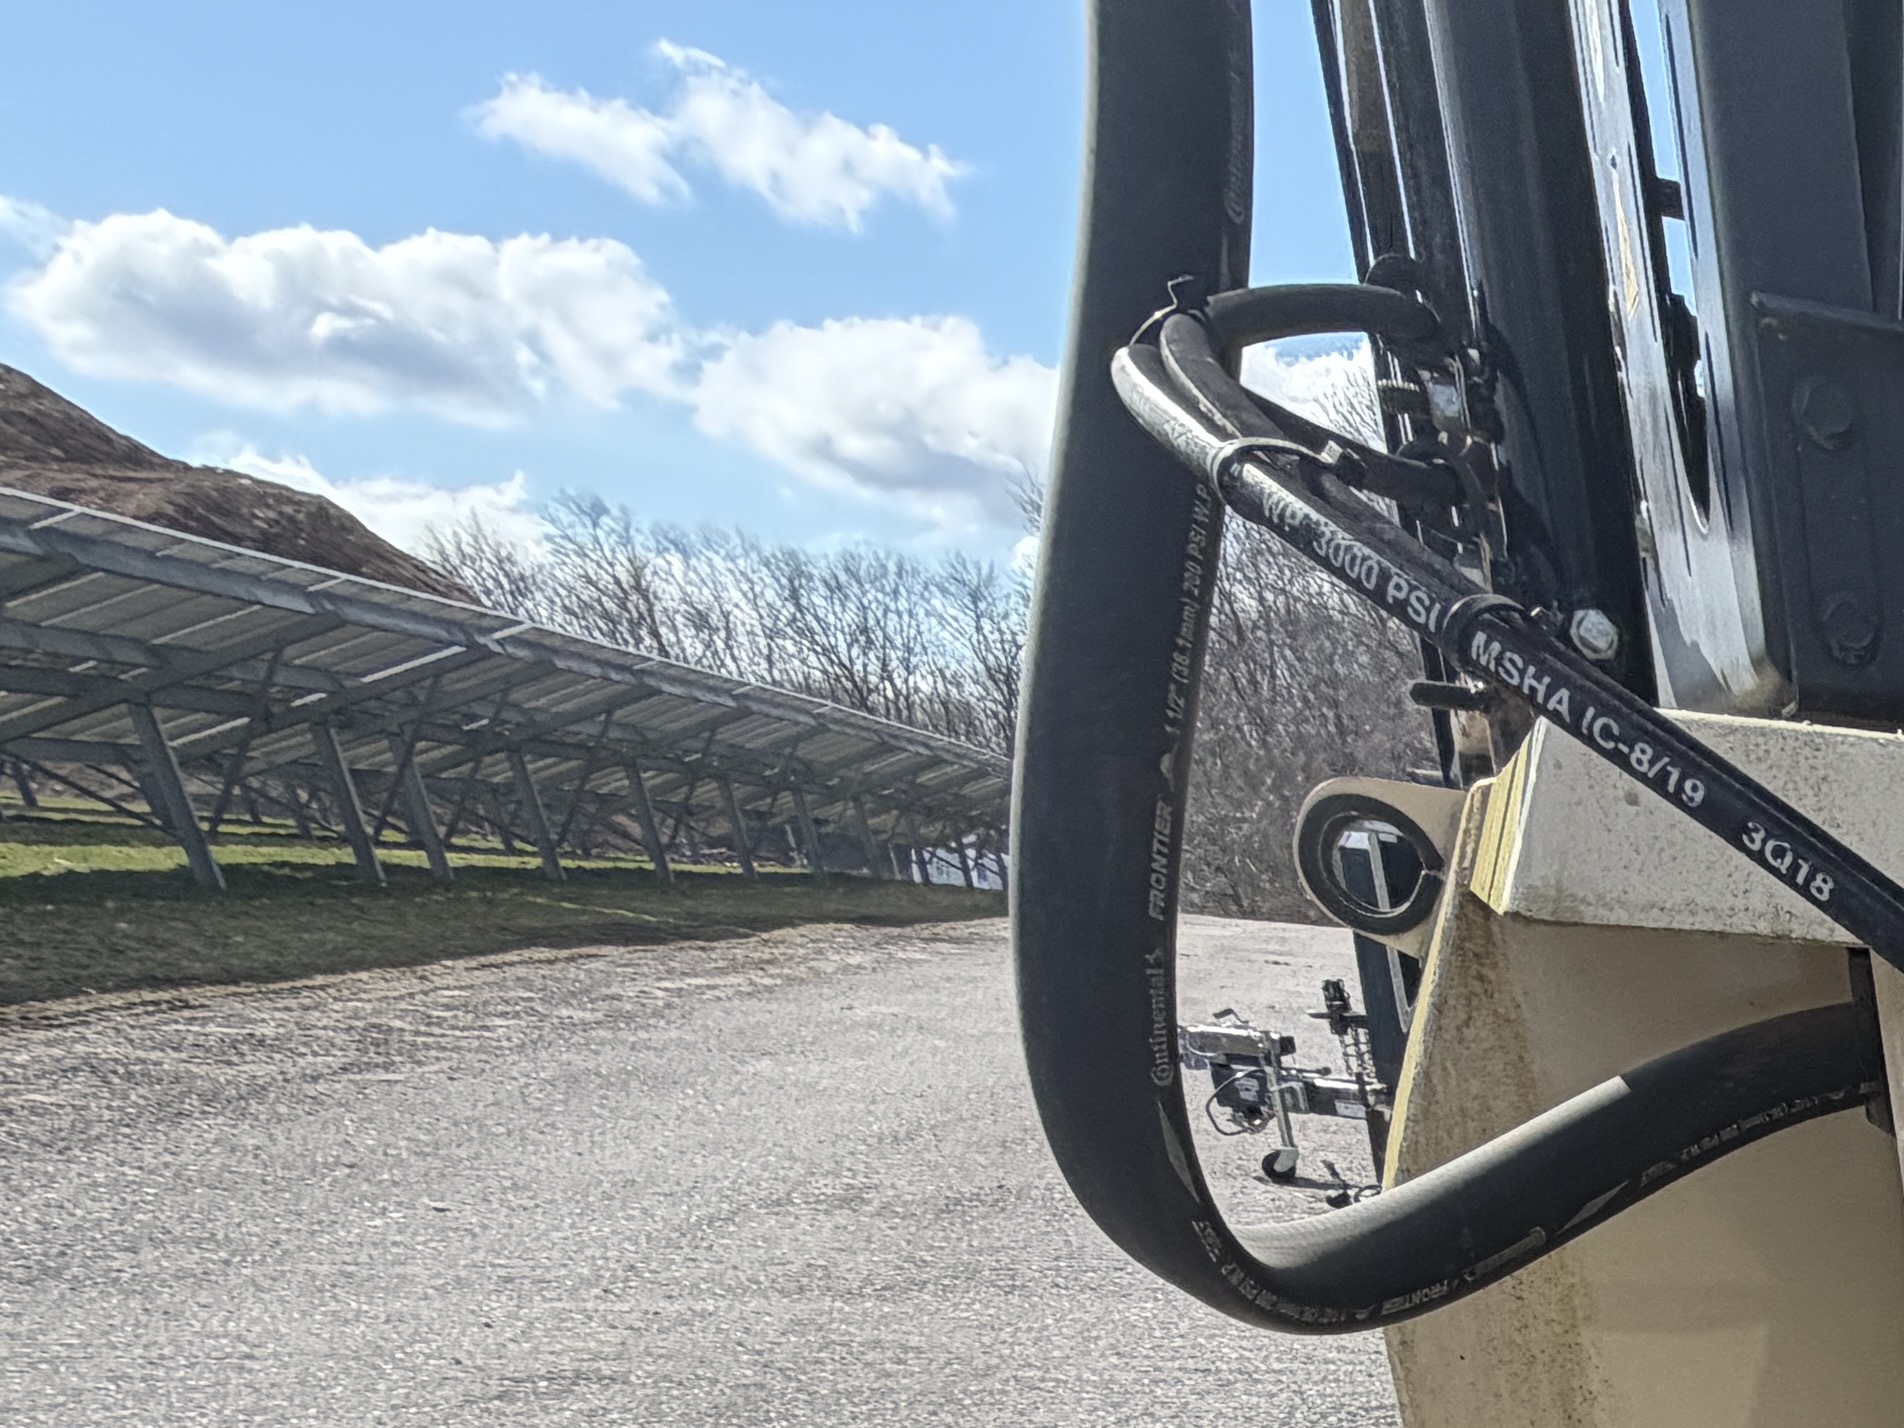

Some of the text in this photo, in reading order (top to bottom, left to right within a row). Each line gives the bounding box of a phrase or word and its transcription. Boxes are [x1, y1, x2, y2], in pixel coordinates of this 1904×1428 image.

[1312, 531, 1380, 591] 3000
[1386, 579, 1442, 634] PSI
[1470, 630, 1573, 724] MSHA
[1582, 705, 1707, 809] IC-8/19
[1740, 821, 1835, 902] 3Q18
[1147, 802, 1174, 921] FRONTIER
